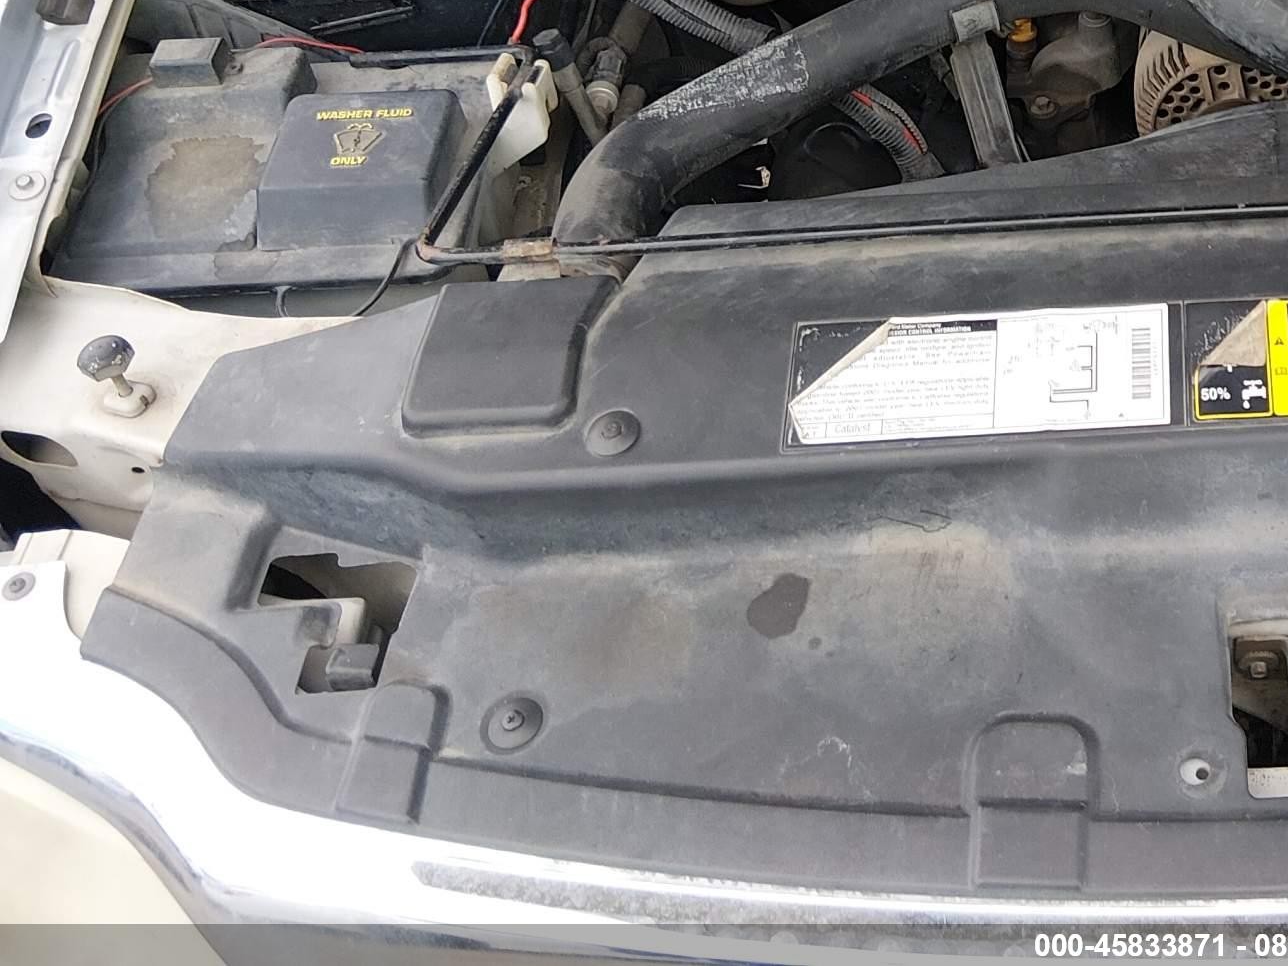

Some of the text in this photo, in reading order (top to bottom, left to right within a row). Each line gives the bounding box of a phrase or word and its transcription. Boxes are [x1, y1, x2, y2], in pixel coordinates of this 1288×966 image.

[316, 108, 413, 121] WASHER FLUID
[330, 156, 367, 166] ONLY
[1200, 386, 1232, 402] 50%
